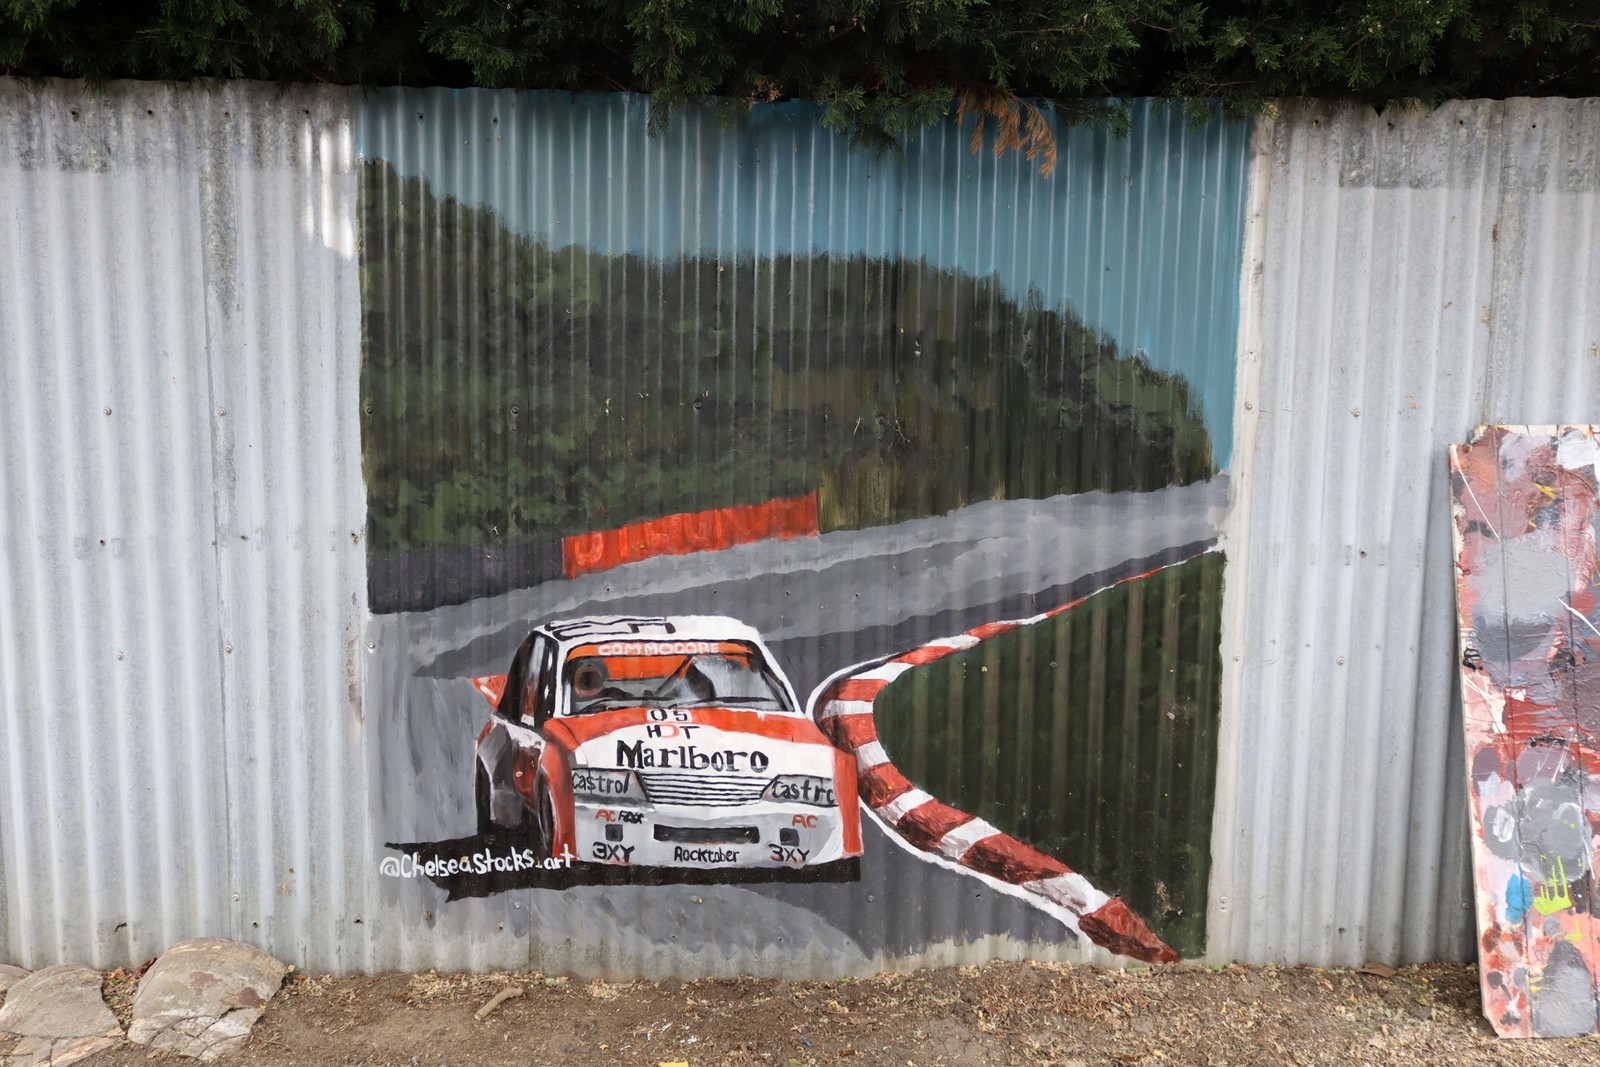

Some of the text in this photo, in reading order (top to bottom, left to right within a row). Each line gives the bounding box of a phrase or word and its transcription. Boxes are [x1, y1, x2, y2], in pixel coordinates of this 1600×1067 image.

[598, 643, 720, 656] COMMODORE
[616, 740, 769, 773] Marlboro
[572, 772, 630, 794] Castrol
[792, 814, 818, 829] AC
[592, 841, 635, 862] 3XY
[674, 846, 740, 862] Rocktober
[768, 843, 810, 862] 3XY
